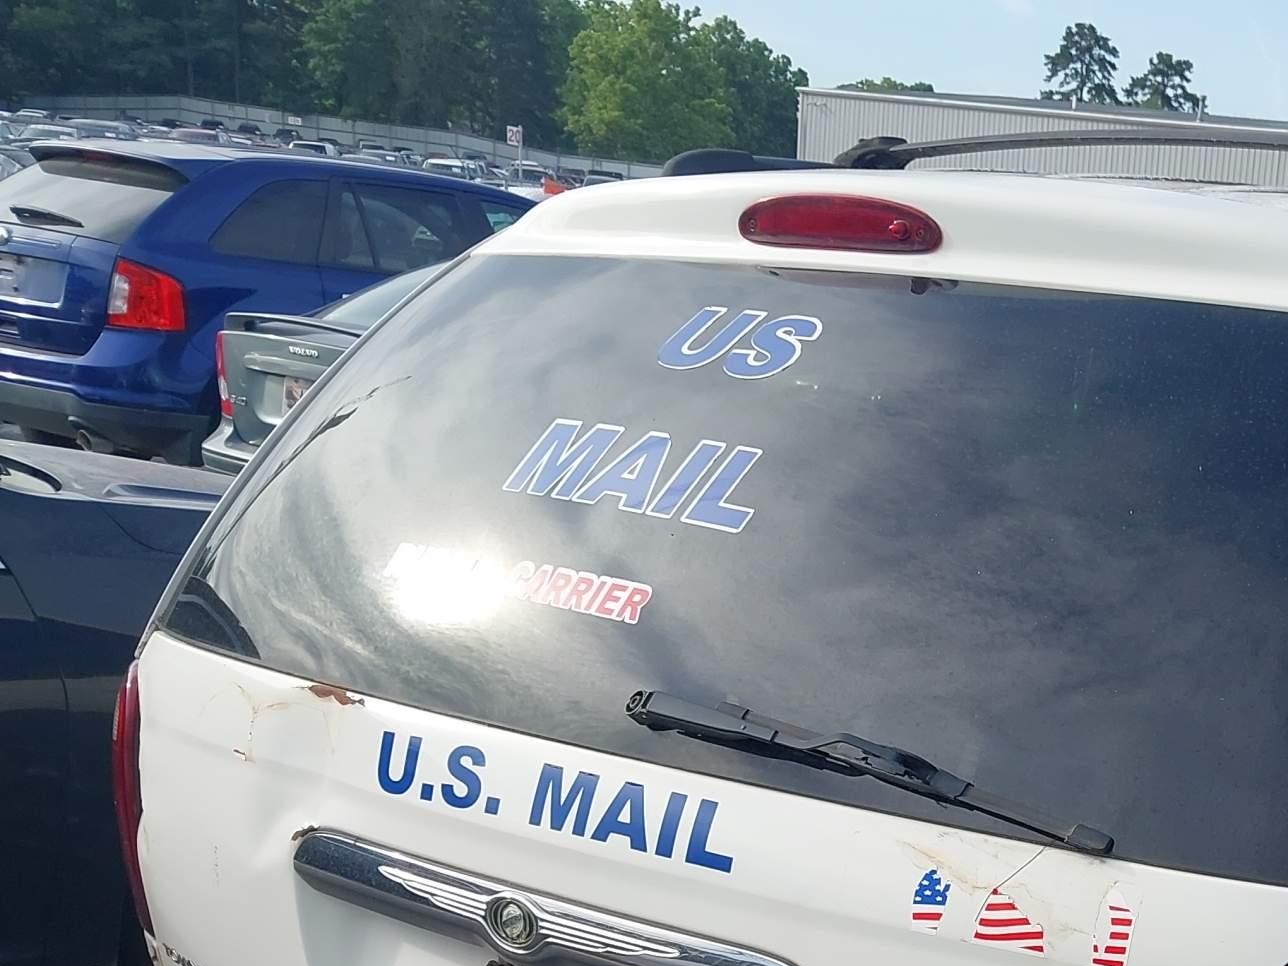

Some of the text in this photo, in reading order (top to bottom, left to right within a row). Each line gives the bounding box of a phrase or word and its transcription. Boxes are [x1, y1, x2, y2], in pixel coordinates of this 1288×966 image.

[508, 128, 521, 144] 20
[288, 345, 319, 359] VOLVO
[656, 305, 823, 380] US
[502, 418, 763, 533] MAIL
[513, 561, 652, 624] CARRIER
[376, 730, 735, 874] U.S. MAIL
